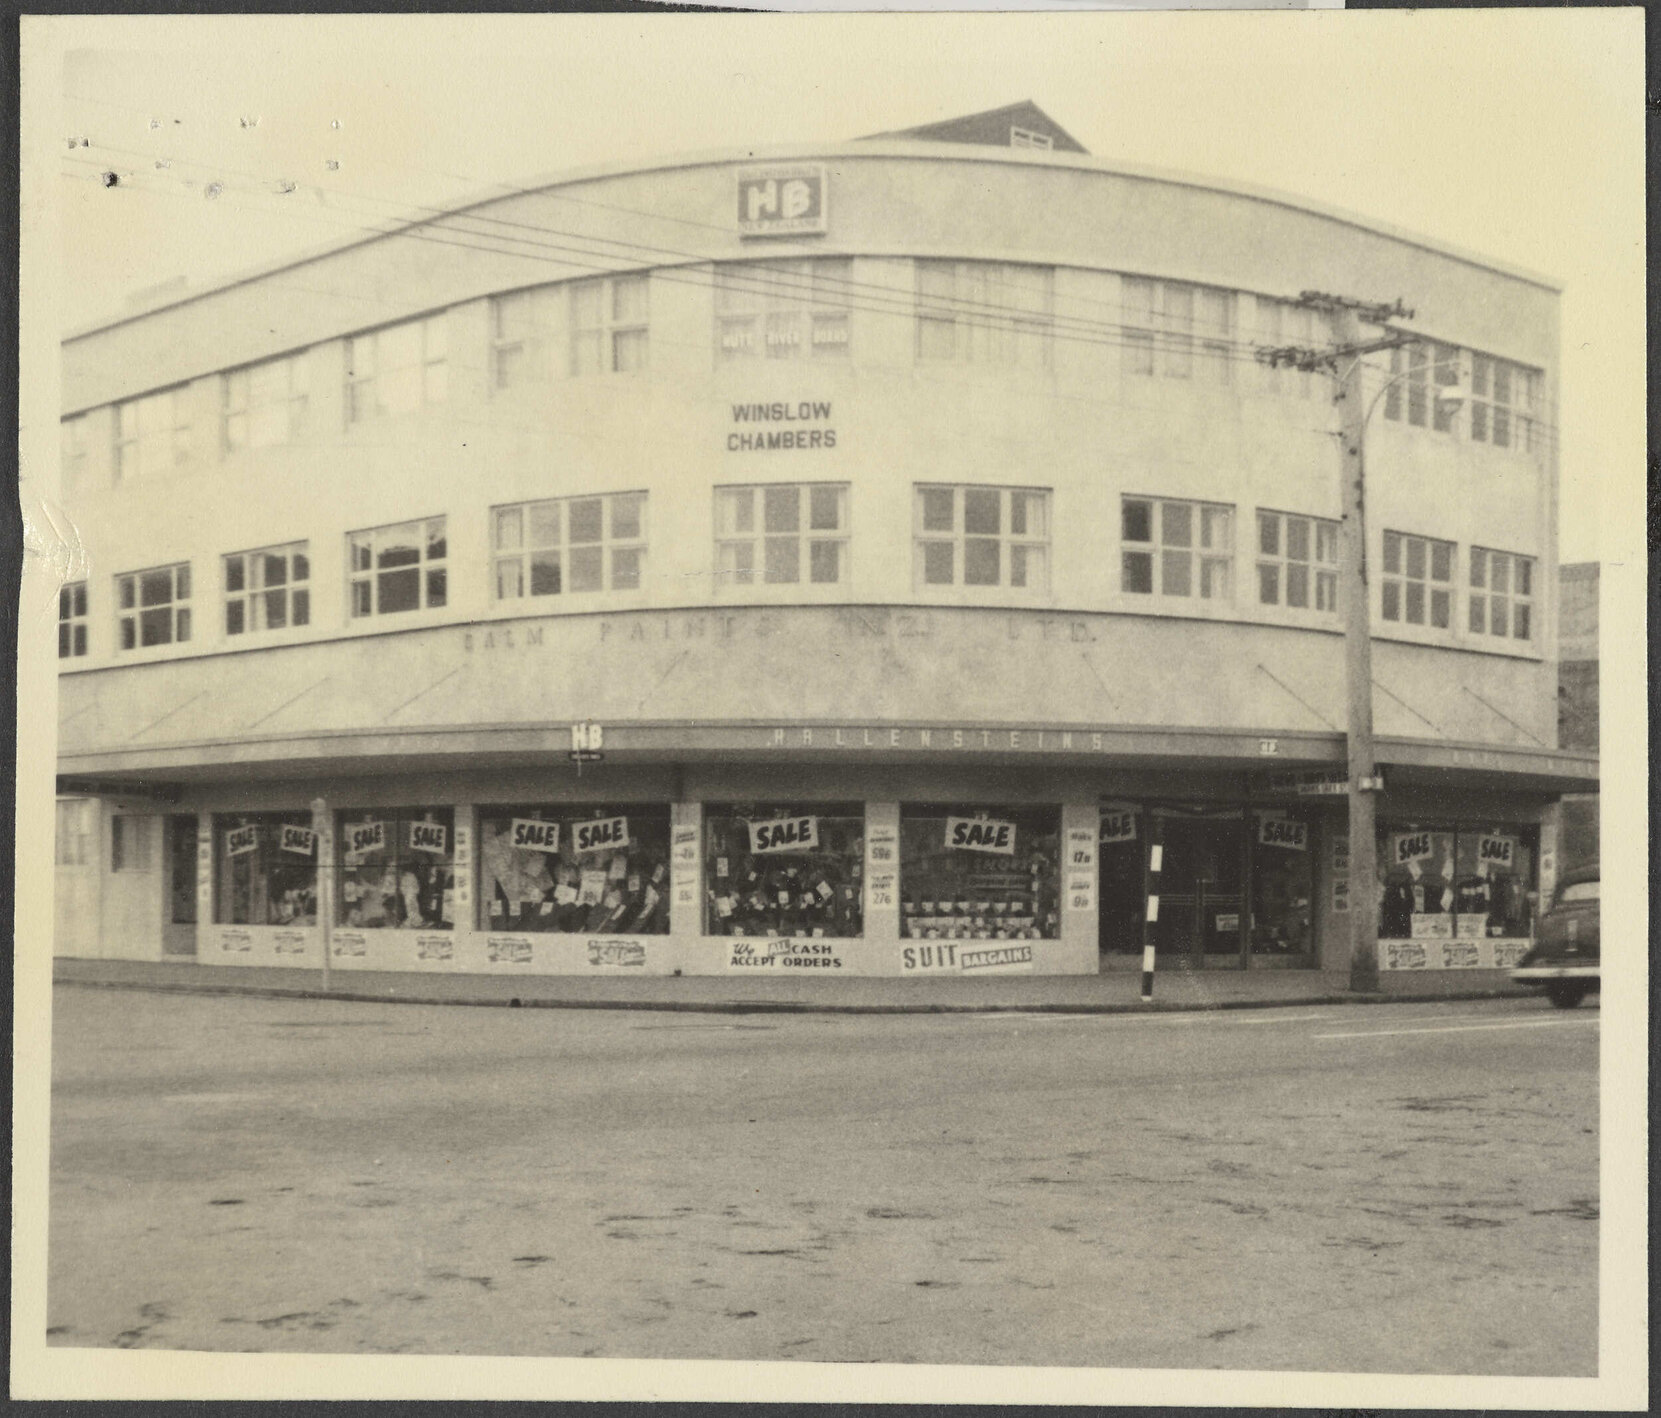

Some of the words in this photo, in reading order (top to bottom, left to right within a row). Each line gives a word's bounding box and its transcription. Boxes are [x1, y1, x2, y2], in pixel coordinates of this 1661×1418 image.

[747, 180, 811, 221] HB
[732, 401, 832, 422] WINSLOW
[726, 430, 837, 452] CHAMBERS
[571, 723, 603, 751] HB
[774, 729, 1103, 752] HALLENSTEINS
[284, 826, 312, 849] SALE
[354, 823, 382, 851] SALE
[413, 826, 444, 849] SALE
[515, 823, 555, 847] SALE
[579, 820, 622, 849] SALE
[756, 818, 812, 850] SALE
[952, 822, 1010, 847] SALE
[1100, 813, 1131, 839] ALE
[1263, 820, 1305, 845] SALE
[229, 828, 255, 852] SALE
[1399, 833, 1430, 861] SALE
[1481, 838, 1510, 861] SALE
[791, 943, 833, 955] CASH
[903, 944, 958, 968] SUIT
[963, 946, 1031, 967] BARGAINS
[730, 956, 776, 967] ACCEPT
[782, 956, 842, 968] ORDERS
